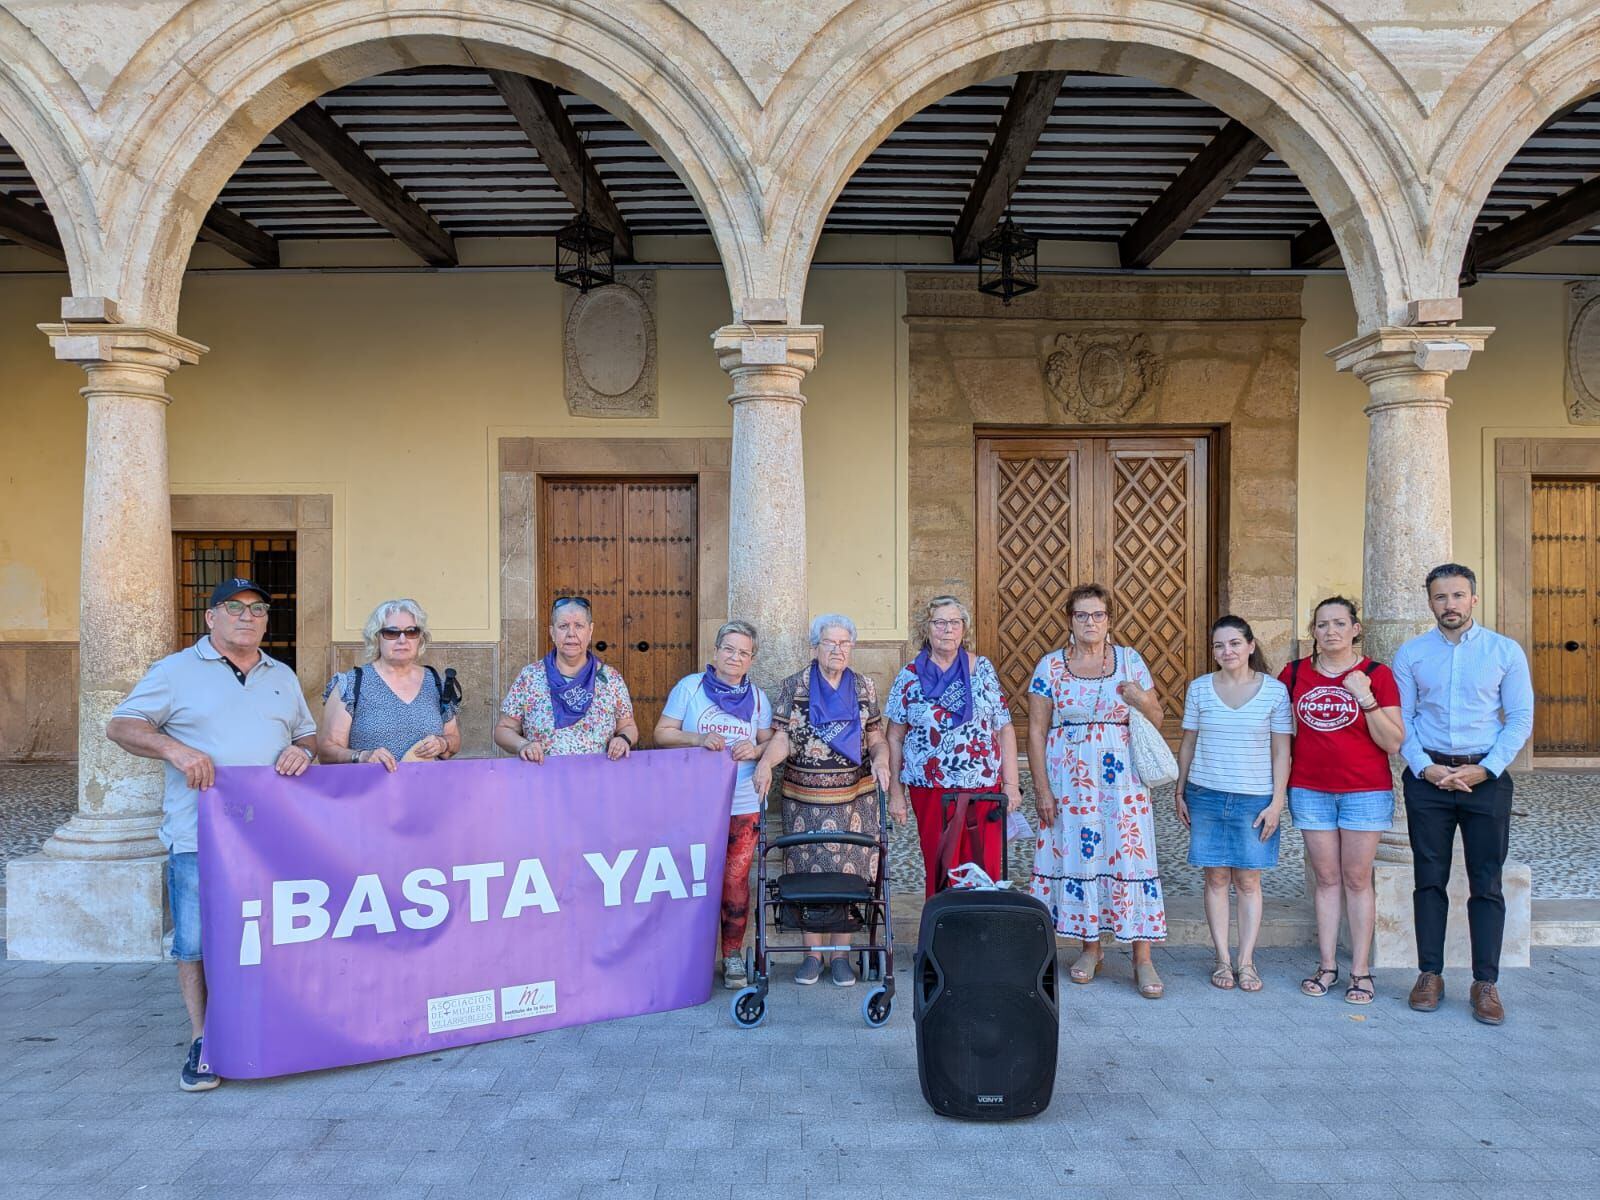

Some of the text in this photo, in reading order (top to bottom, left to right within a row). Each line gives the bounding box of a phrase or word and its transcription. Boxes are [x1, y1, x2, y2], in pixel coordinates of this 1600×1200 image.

[1299, 702, 1356, 713] HOSPITAL
[701, 723, 750, 737] HOSPITAL
[239, 843, 708, 966] ¡BASTA YA!
[452, 1003, 493, 1015] MUJERES
